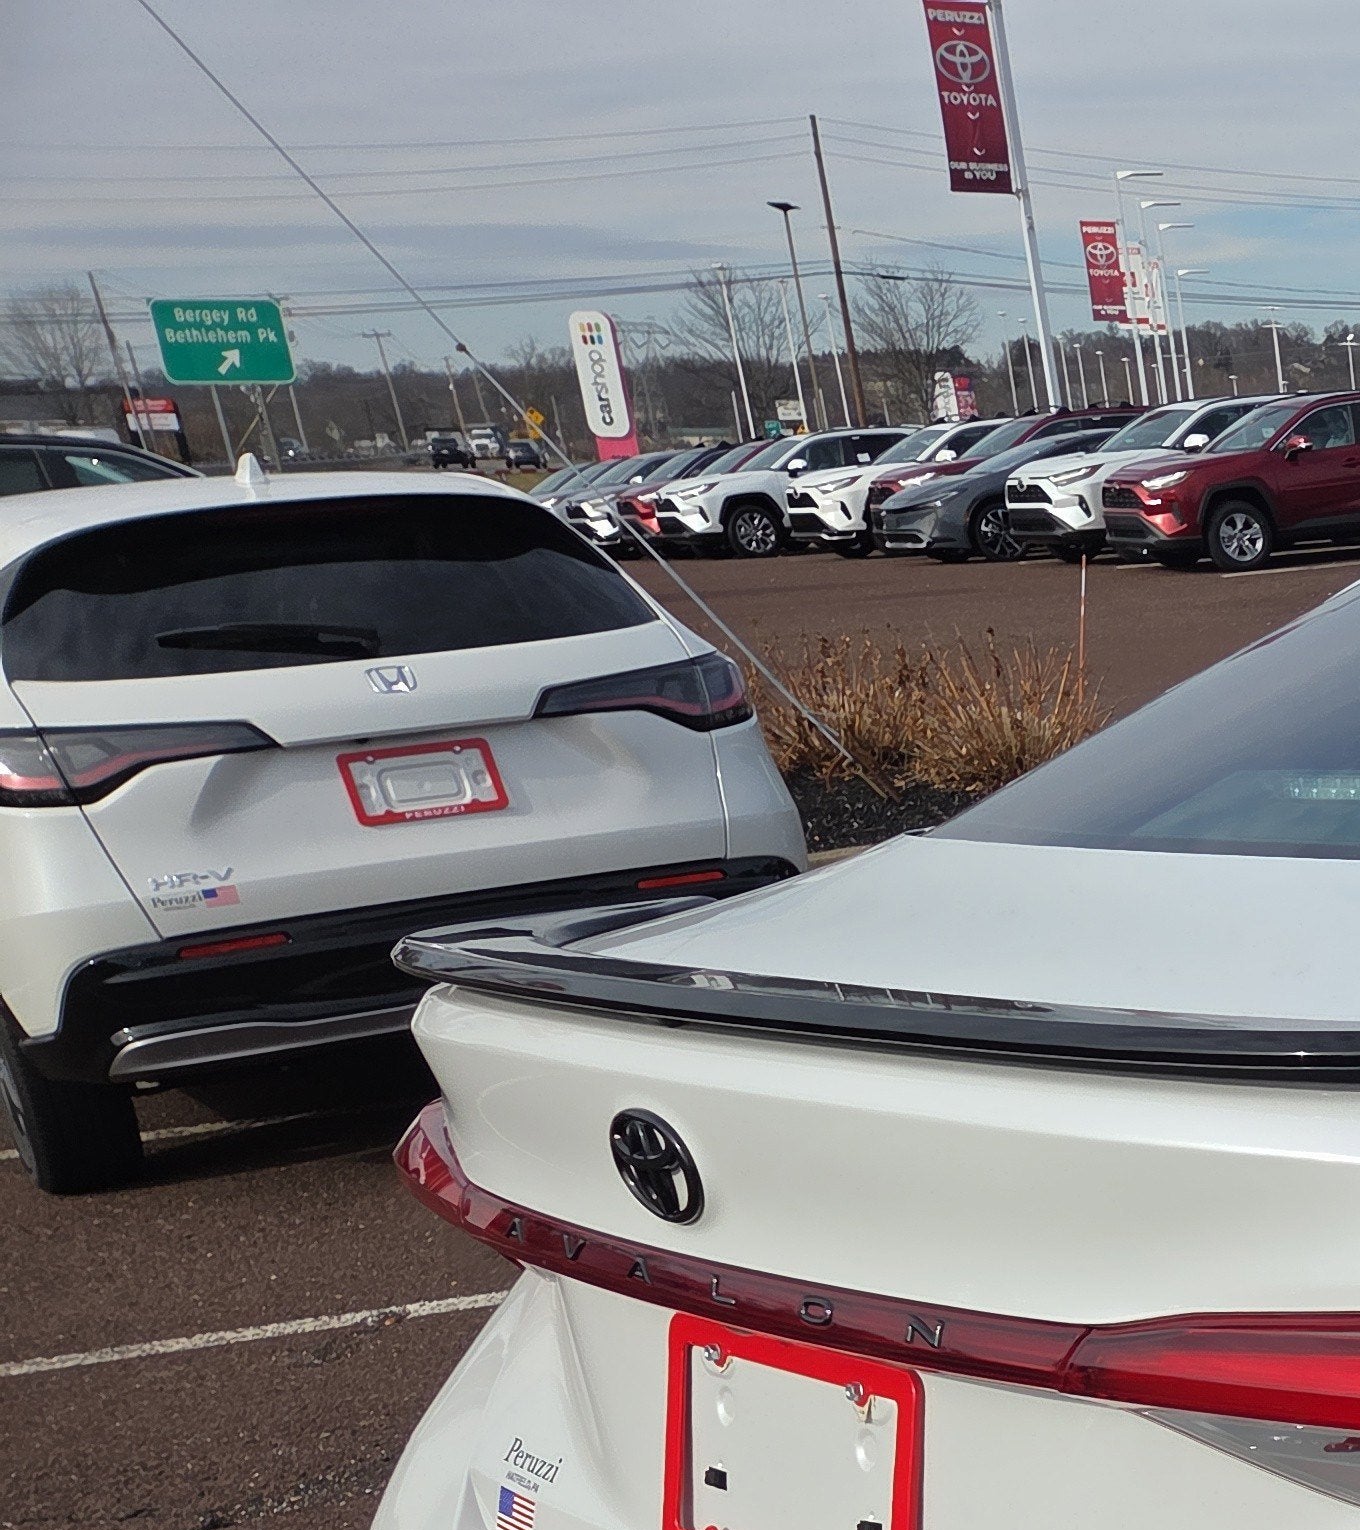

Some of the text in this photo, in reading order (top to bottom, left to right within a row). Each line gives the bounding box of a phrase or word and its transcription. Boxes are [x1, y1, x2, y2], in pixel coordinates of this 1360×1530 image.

[927, 8, 985, 25] PERUZZI
[941, 91, 997, 108] TOYOTA
[1089, 268, 1120, 277] TOYOTA
[173, 307, 258, 326] Bergey Rd
[164, 327, 278, 344] Bethlehem Pk
[588, 349, 615, 426] carshop
[404, 805, 466, 820] PERUZZI
[147, 867, 234, 892] HR-V
[504, 1217, 946, 1349] AVALON
[503, 1437, 563, 1484] Peruzzi
